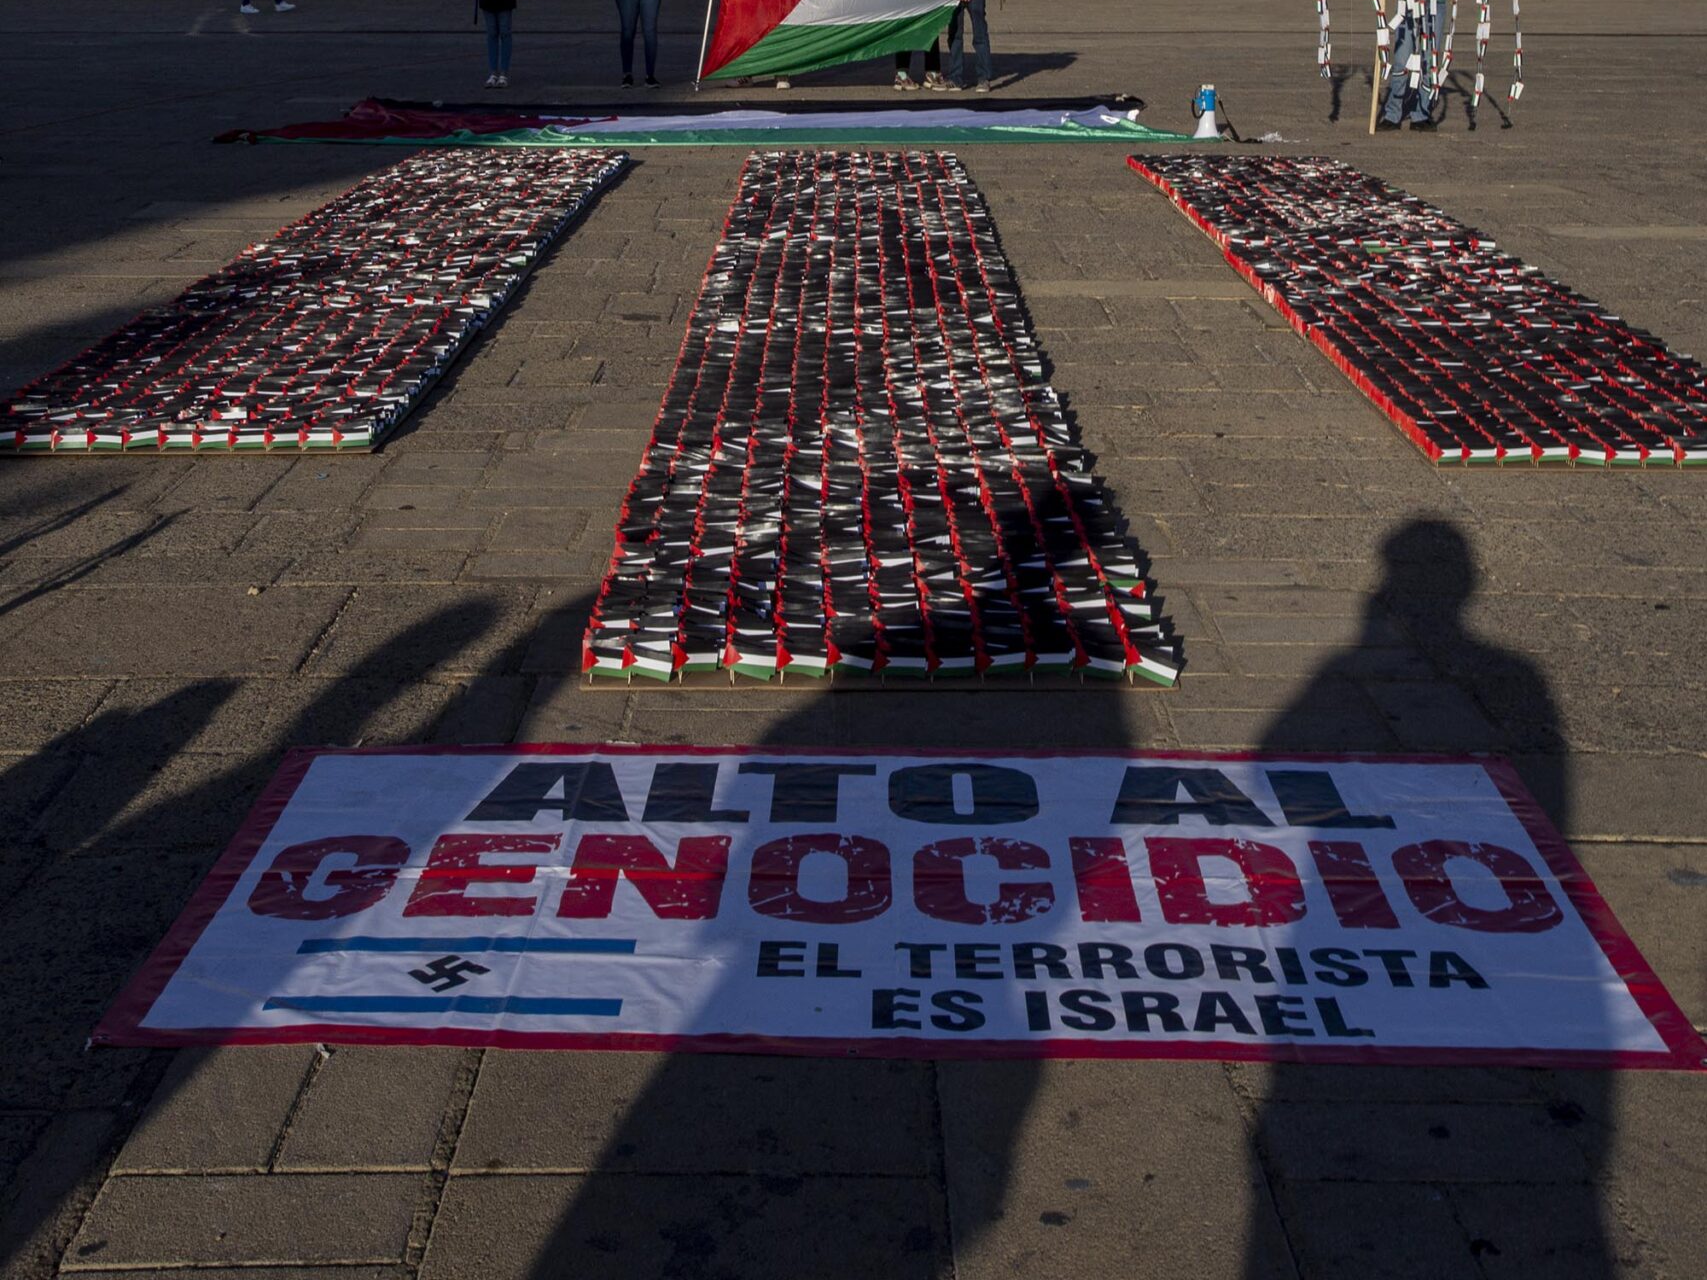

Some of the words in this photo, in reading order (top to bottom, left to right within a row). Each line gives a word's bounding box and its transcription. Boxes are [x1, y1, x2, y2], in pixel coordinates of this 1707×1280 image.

[464, 761, 1039, 825] ALTO
[1109, 766, 1397, 829] AL
[246, 833, 1565, 933] GENOCIDIO
[756, 941, 862, 978] EL
[894, 942, 1492, 990] TERRORISTA
[872, 988, 987, 1032] ES
[1025, 990, 1376, 1038] ISRAEL
